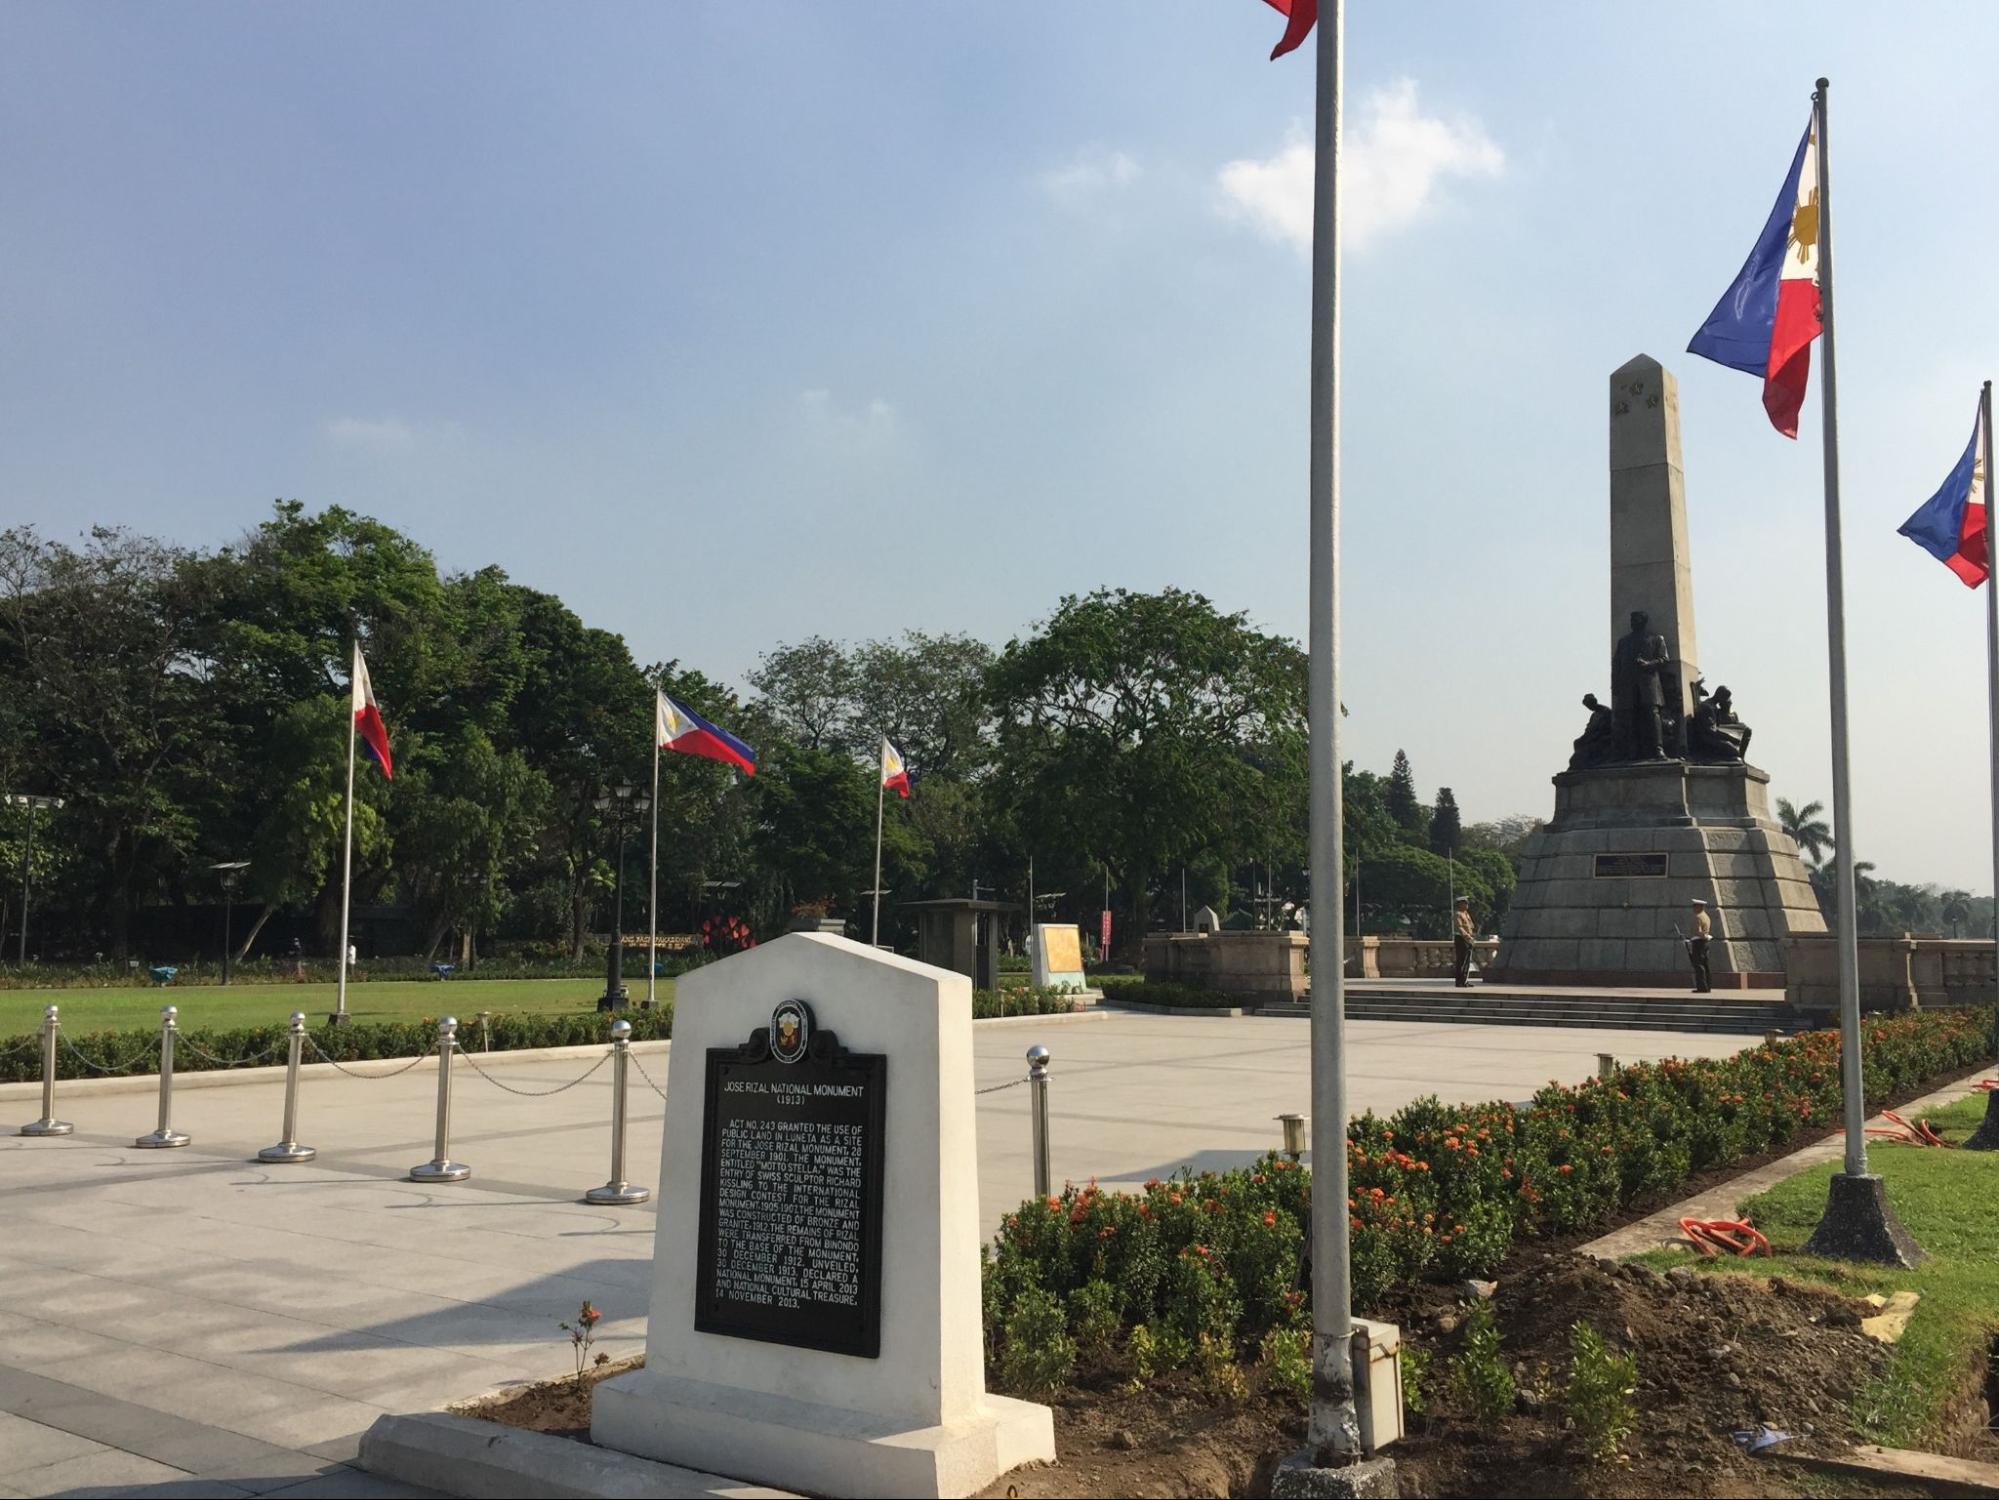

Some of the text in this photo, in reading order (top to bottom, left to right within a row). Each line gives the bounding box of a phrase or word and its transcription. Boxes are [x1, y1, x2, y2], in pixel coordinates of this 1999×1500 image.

[724, 1081, 864, 1097] JOSE RIZAL NATIONAL MONUMENT
[777, 1095, 805, 1105] (1913)
[729, 1119, 743, 1128] ACT
[760, 1121, 775, 1131] 243
[777, 1121, 815, 1133] GRANTED
[816, 1124, 832, 1134] THE
[833, 1125, 849, 1135] USE
[851, 1125, 863, 1136] OF
[722, 1128, 748, 1139] PUBLIC
[750, 1130, 772, 1140] LAND
[775, 1132, 783, 1141] IN
[785, 1132, 816, 1143] LUNETA
[820, 1134, 830, 1144] AS
[843, 1135, 862, 1146] SITE
[721, 1138, 736, 1148] FOR
[738, 1139, 752, 1149] THE
[754, 1140, 774, 1151] JOSE
[776, 1142, 799, 1153] RIZAL
[851, 1146, 862, 1157] 28
[721, 1149, 766, 1160] SEPTEMBER
[793, 1153, 809, 1163] THE
[720, 1158, 755, 1169] ENTITLED
[827, 1167, 844, 1176] WAS
[846, 1167, 861, 1178] THE
[720, 1168, 861, 1188] ENTRY OF SWISS SCULPTOR RICHARD
[720, 1178, 861, 1199] KISSLING TO THE INTERNATIONAL
[719, 1188, 860, 1209] DESIGN CONTEST FOR THE RIZAL
[719, 1208, 860, 1231] WAS CONSTRUCTED OF BRONZE AND
[799, 1205, 814, 1216] THE
[815, 1207, 860, 1220] MONUMENT
[719, 1229, 860, 1251] WERE TRANSFERRED FROM BINONDO
[770, 1223, 785, 1233] THE
[787, 1225, 822, 1237] REMAINS
[823, 1229, 835, 1238] OF
[836, 1229, 859, 1241] RIZAL
[717, 1248, 728, 1258] 30
[733, 1249, 777, 1264] DECEMBER
[718, 1238, 728, 1247] TO
[731, 1239, 746, 1250] THE
[749, 1241, 770, 1253] BASE
[773, 1244, 784, 1254] OF
[789, 1245, 804, 1256] THE
[717, 1258, 727, 1268] 30
[731, 1260, 775, 1274] DECEMBER
[803, 1268, 848, 1282] DECLARED
[716, 1269, 752, 1282] NATIONAL
[800, 1278, 809, 1288] 15
[812, 1279, 836, 1292] APRIL
[839, 1283, 858, 1295] 2013
[716, 1278, 732, 1289] AND
[733, 1280, 769, 1295] NATIONAL
[771, 1285, 811, 1300] CULTURAL
[715, 1288, 724, 1298] 14
[728, 1290, 773, 1305] NOVEMBER
